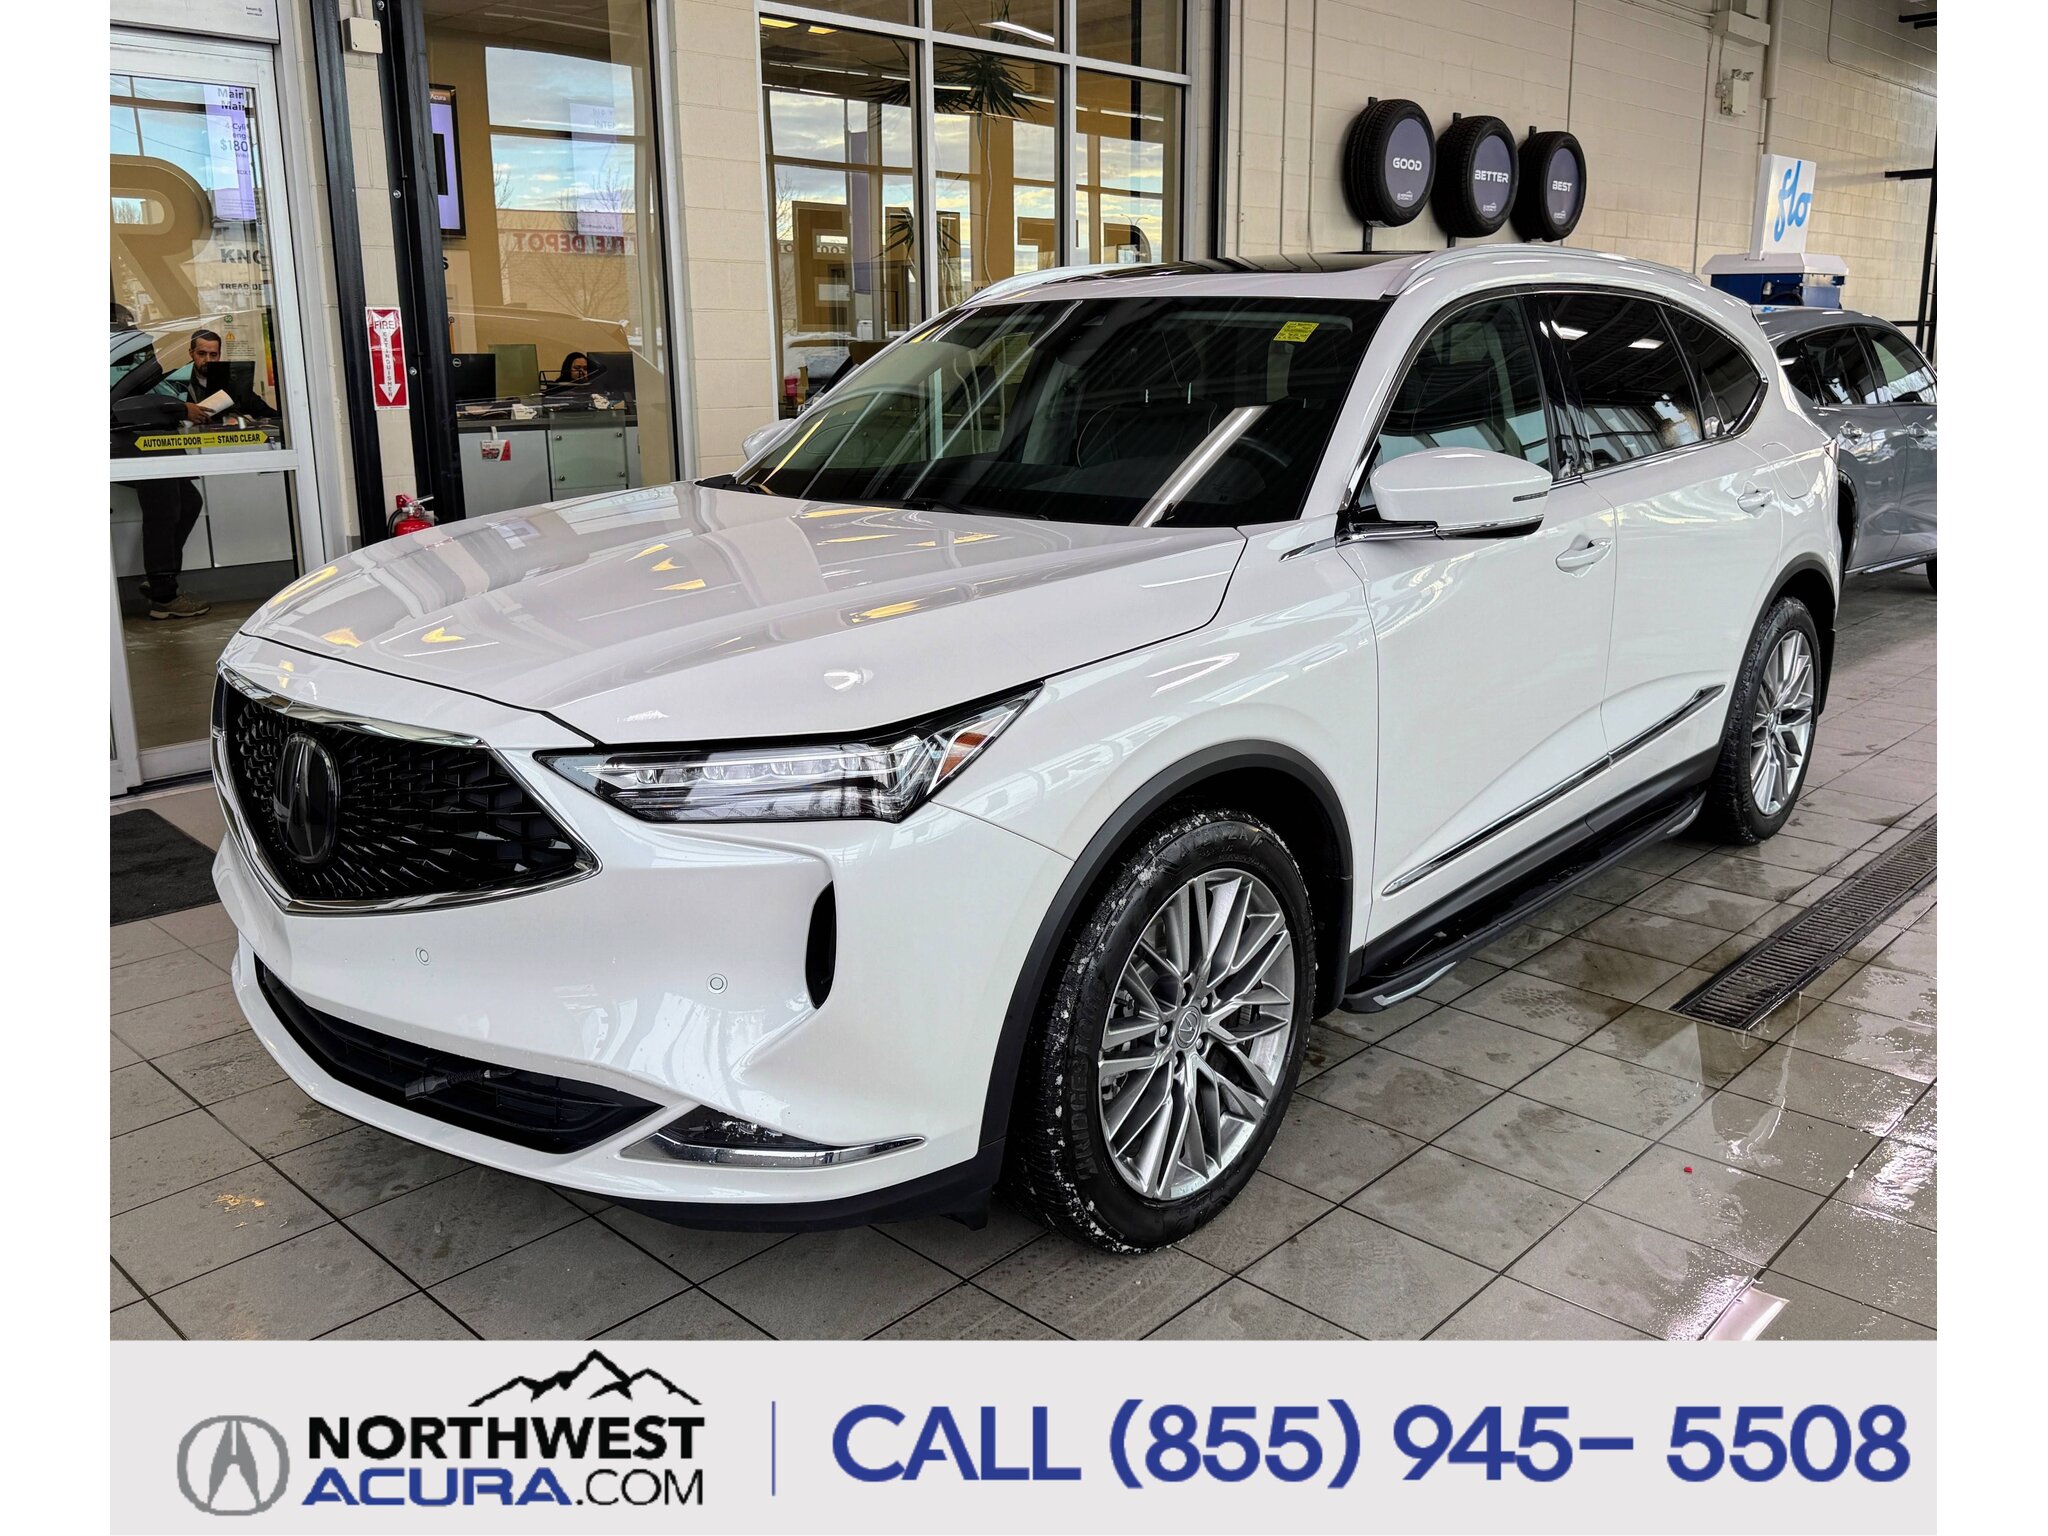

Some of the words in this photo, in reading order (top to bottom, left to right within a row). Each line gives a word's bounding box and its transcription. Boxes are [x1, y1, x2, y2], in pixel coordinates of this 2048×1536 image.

[1393, 157, 1422, 171] GOOD
[1474, 169, 1509, 184] BETTER
[1552, 180, 1573, 192] BEST
[374, 320, 395, 330] FIRE
[143, 438, 182, 448] AUTOMATIC
[183, 436, 202, 445] DOOR
[217, 435, 239, 444] STAND
[240, 433, 260, 442] CLEAR
